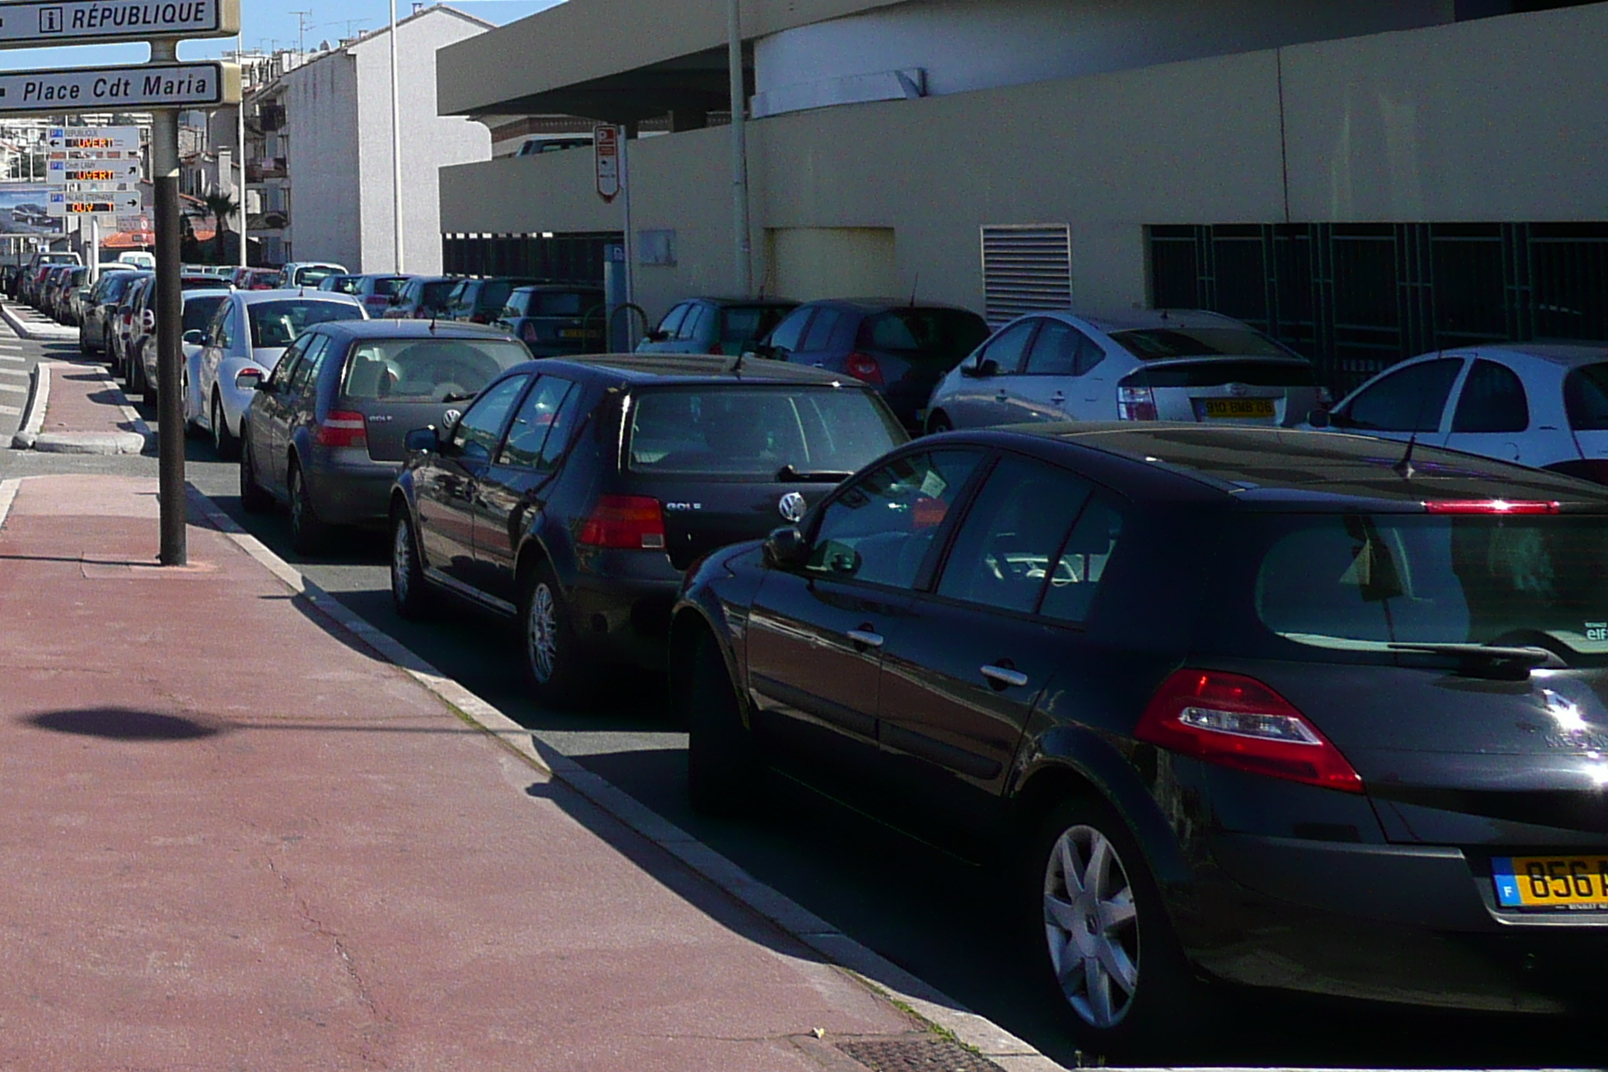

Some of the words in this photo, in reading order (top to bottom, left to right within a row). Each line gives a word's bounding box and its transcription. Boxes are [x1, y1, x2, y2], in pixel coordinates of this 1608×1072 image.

[71, 1, 206, 29] RÉPUBLIQUE
[23, 82, 80, 102] Place
[93, 77, 131, 97] Cdt
[142, 74, 207, 96] Maria
[73, 171, 113, 180] UVERT
[1503, 885, 1514, 898] F
[1526, 860, 1594, 898] 856
